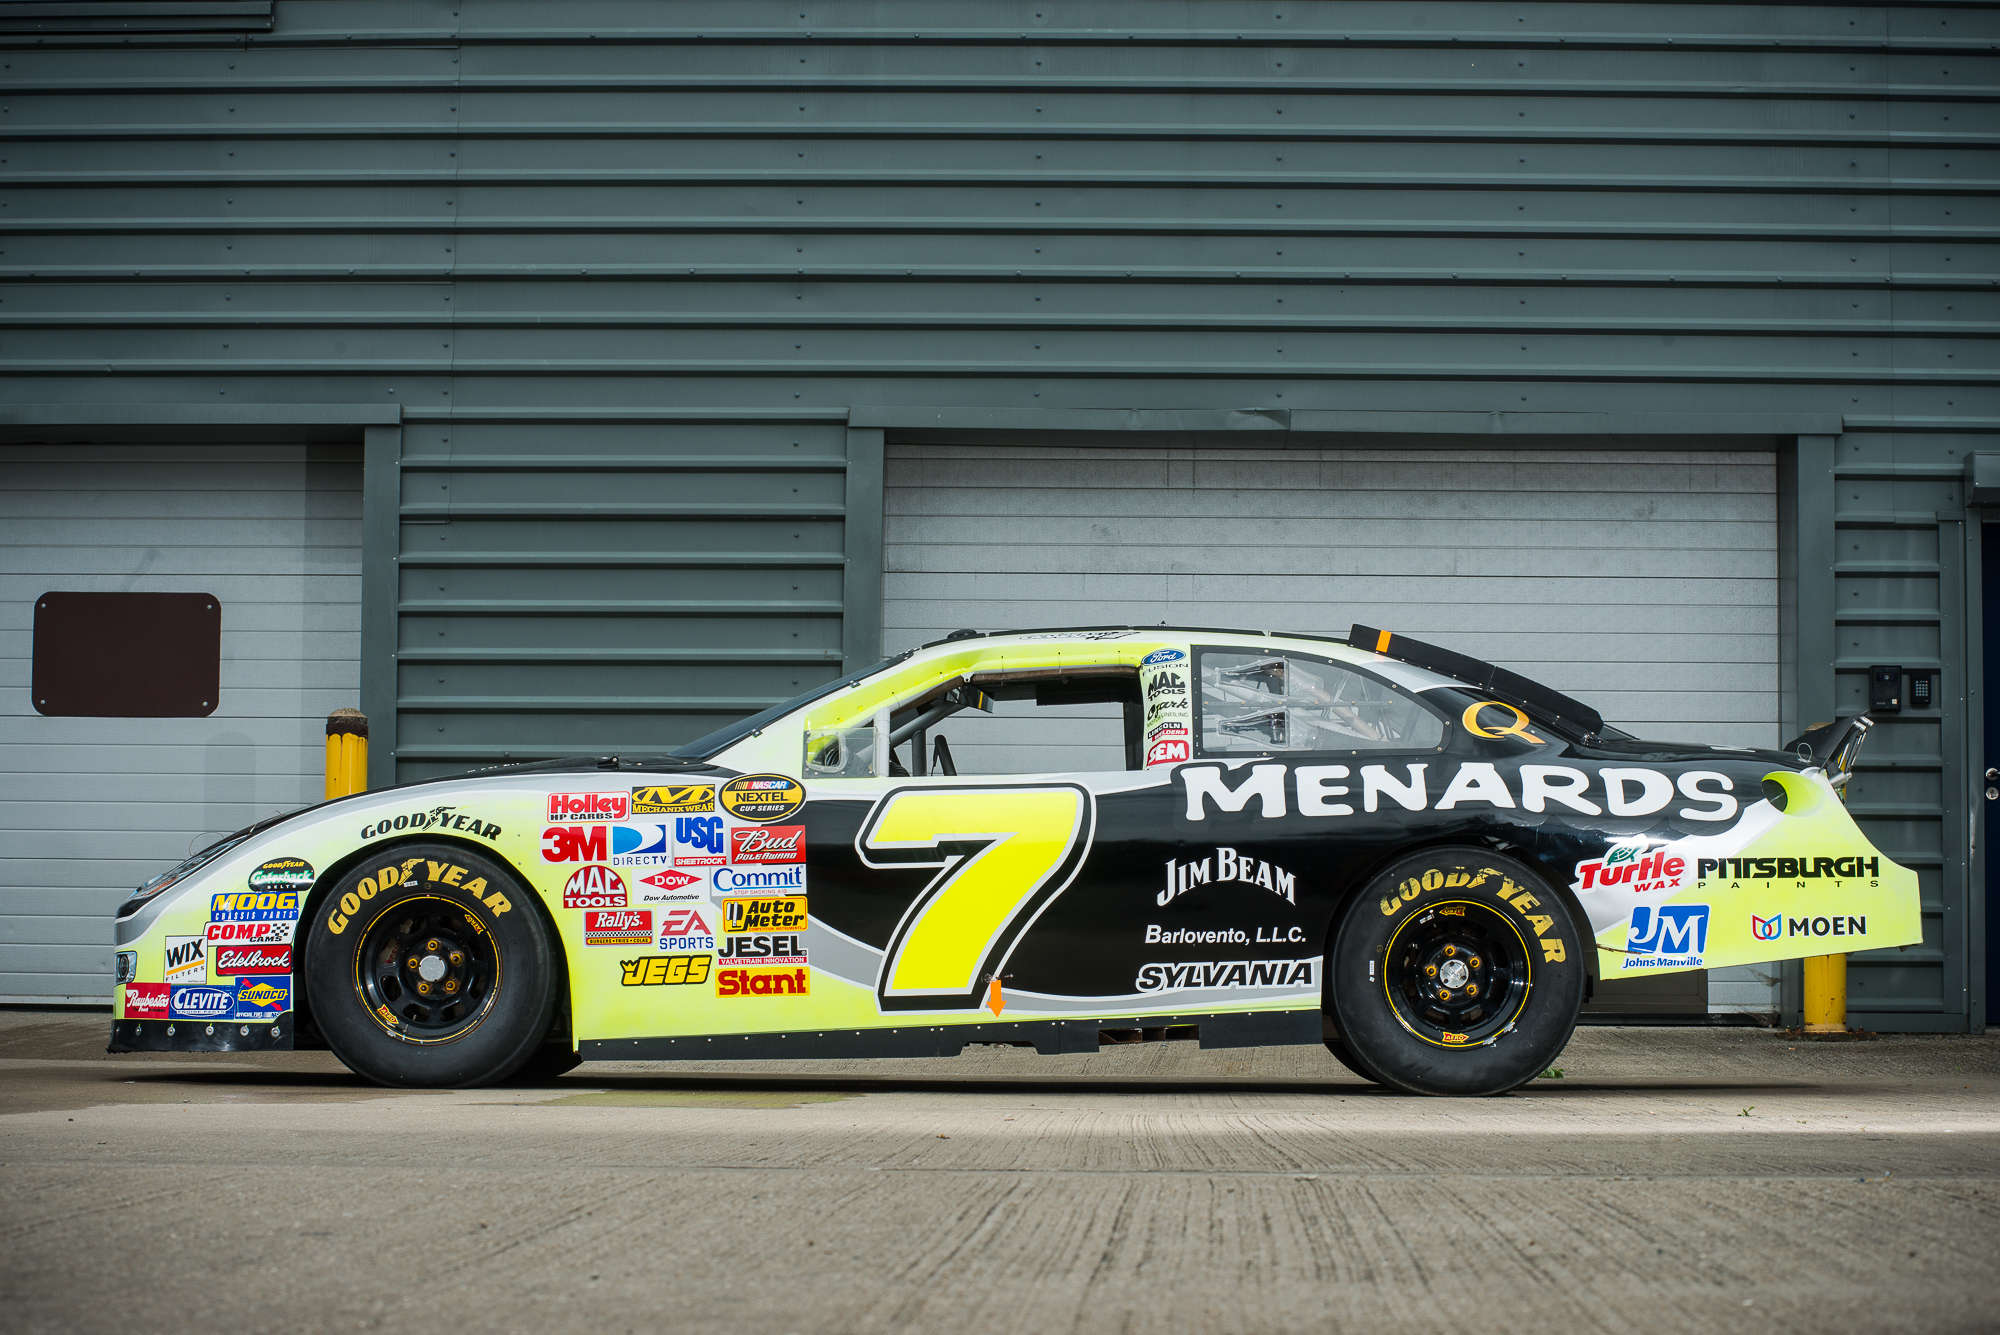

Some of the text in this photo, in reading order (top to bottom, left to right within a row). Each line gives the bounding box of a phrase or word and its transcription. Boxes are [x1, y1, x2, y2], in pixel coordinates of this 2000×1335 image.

[1151, 650, 1176, 662] Ford
[1145, 664, 1189, 673] USION
[1148, 671, 1185, 697] MAC
[1148, 689, 1185, 701] TOOLS
[1462, 700, 1546, 744] Q
[1148, 742, 1187, 763] SEM
[751, 781, 787, 789] NASCAR
[1180, 762, 1738, 821] MENARDS
[550, 794, 626, 818] Holley
[736, 792, 790, 802] NEXTEL
[632, 803, 714, 813] MECHANIX WEAR
[757, 804, 784, 812] SERIES
[542, 826, 607, 862] 3M
[676, 816, 723, 854] USG
[733, 830, 802, 853] Bud
[613, 856, 667, 866] DIRECTV
[676, 857, 725, 866] SHEETROCK
[736, 853, 762, 861] POLE
[1156, 847, 1296, 907] JIM BEAM
[1579, 851, 1685, 889] Turtle
[1698, 857, 1879, 879] PITTSBURGH
[565, 867, 625, 896] MAC
[654, 875, 690, 886] DOW
[713, 867, 803, 892] Commit
[1634, 879, 1681, 893] WAX
[1698, 880, 1879, 889] PAINTS
[212, 893, 296, 912] MOOG
[565, 896, 626, 908] TOOLS
[858, 783, 1092, 1011] 7
[215, 911, 294, 921] CHASSIS PARTS
[747, 900, 795, 914] Auto
[595, 911, 641, 930] Rally's
[661, 910, 712, 936] EA
[743, 914, 804, 930] Meter
[1628, 905, 1710, 954] JM
[1789, 916, 1866, 936] MOEN
[207, 923, 270, 940] COMP
[250, 935, 282, 943] CAMS
[1145, 925, 1306, 946] Barlovento, L.L.C.
[659, 937, 714, 950] SPORTS
[718, 935, 802, 957] JESEL
[166, 939, 205, 968] WIX
[218, 950, 290, 969] Edelbrock
[1624, 956, 1703, 968] Johns Manville
[166, 966, 205, 981] FILTERS
[621, 954, 713, 987] JEGS
[1137, 958, 1315, 991] SYLVANIA
[718, 969, 806, 995] Stant
[174, 988, 230, 1009] CLEVITE
[239, 990, 287, 1000] SUNOCO
